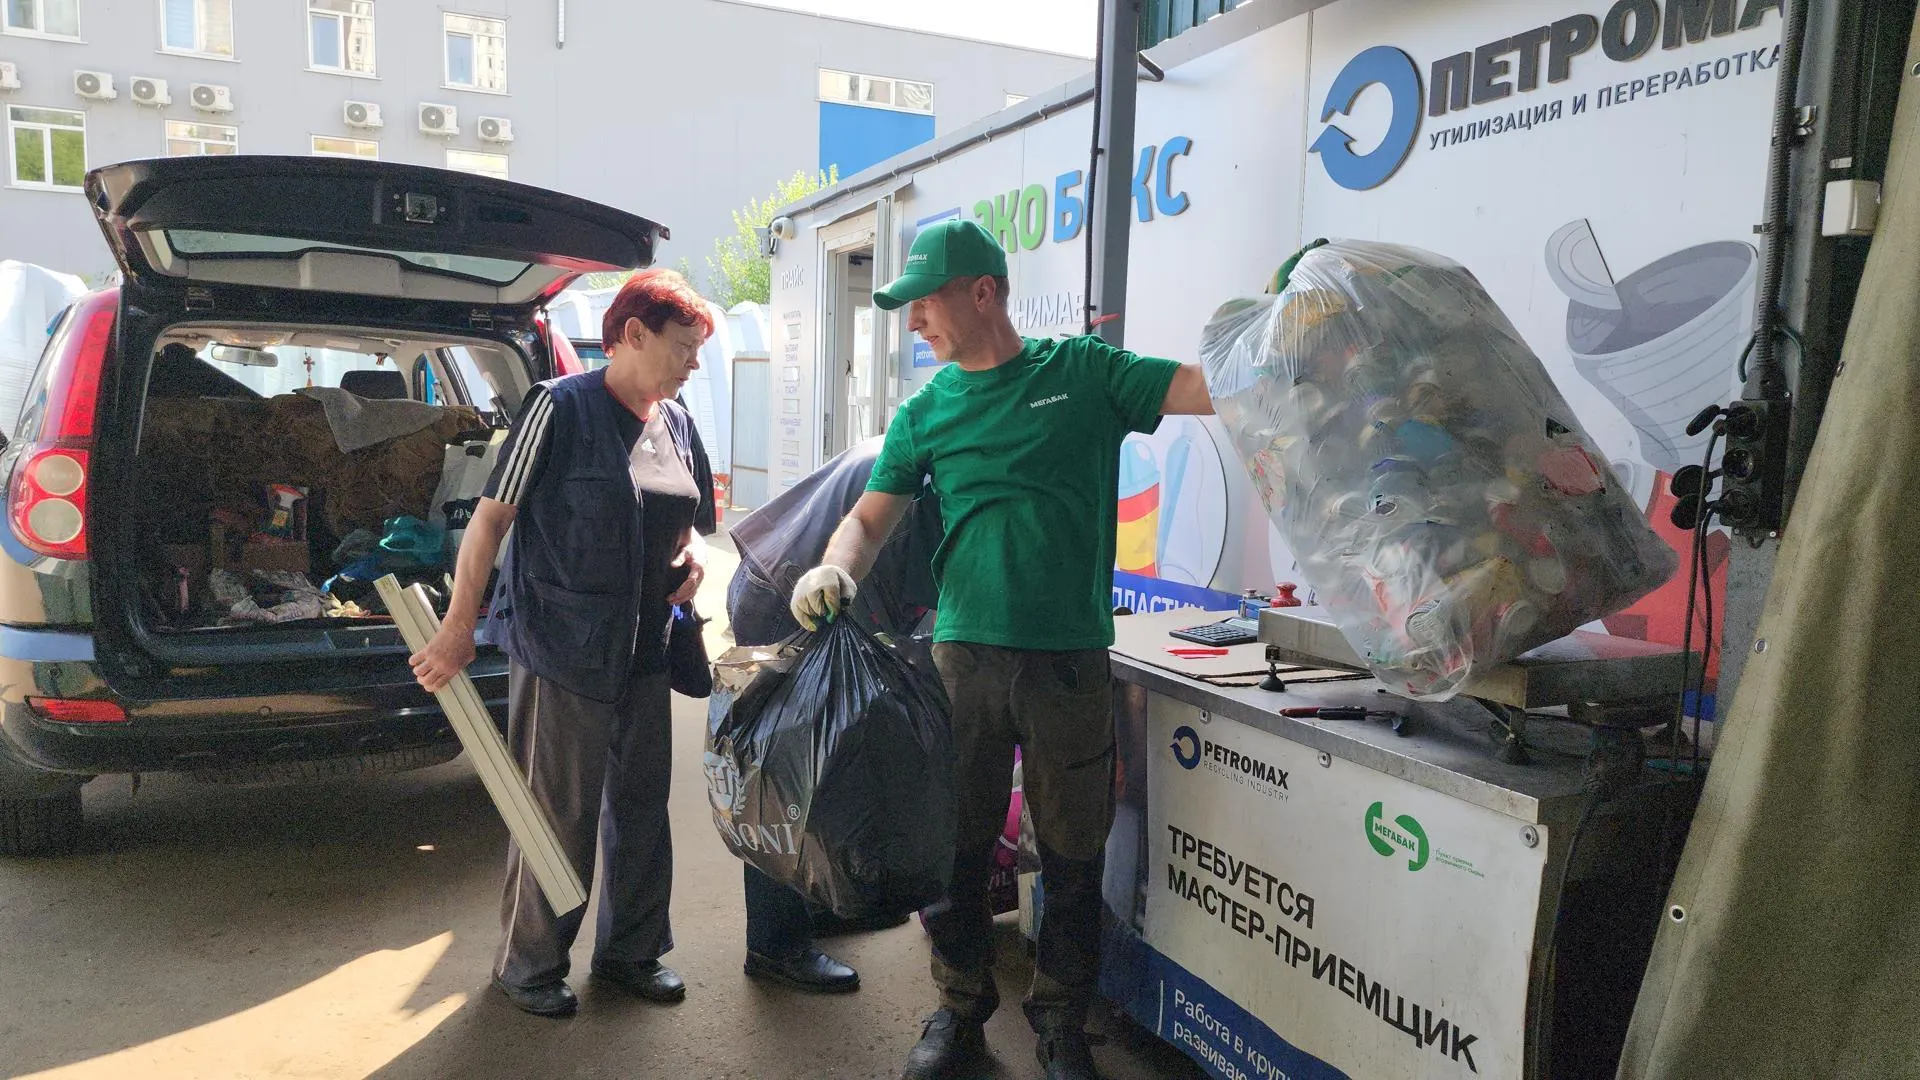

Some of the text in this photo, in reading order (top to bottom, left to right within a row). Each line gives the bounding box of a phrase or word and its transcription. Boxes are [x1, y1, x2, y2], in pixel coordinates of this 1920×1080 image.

[1429, 44, 1781, 151] УТИЛИЗАЦИЯ И ПЕРЕРАБОТКА
[1053, 135, 1193, 244] БКС
[782, 264, 804, 290] ПРАЙС
[1030, 393, 1069, 408] МЕГАБАК
[1203, 760, 1289, 803] RECYCLING INDUSTRY
[1204, 740, 1289, 790] PETROMAX
[1374, 822, 1416, 852] МЕГАБАК
[1167, 824, 1315, 929] ТРЕБУЕТСЯ
[1167, 864, 1480, 1073] МАСТЕР-ПРИЕМЩИК
[1174, 988, 1291, 1080] Работа в круп
